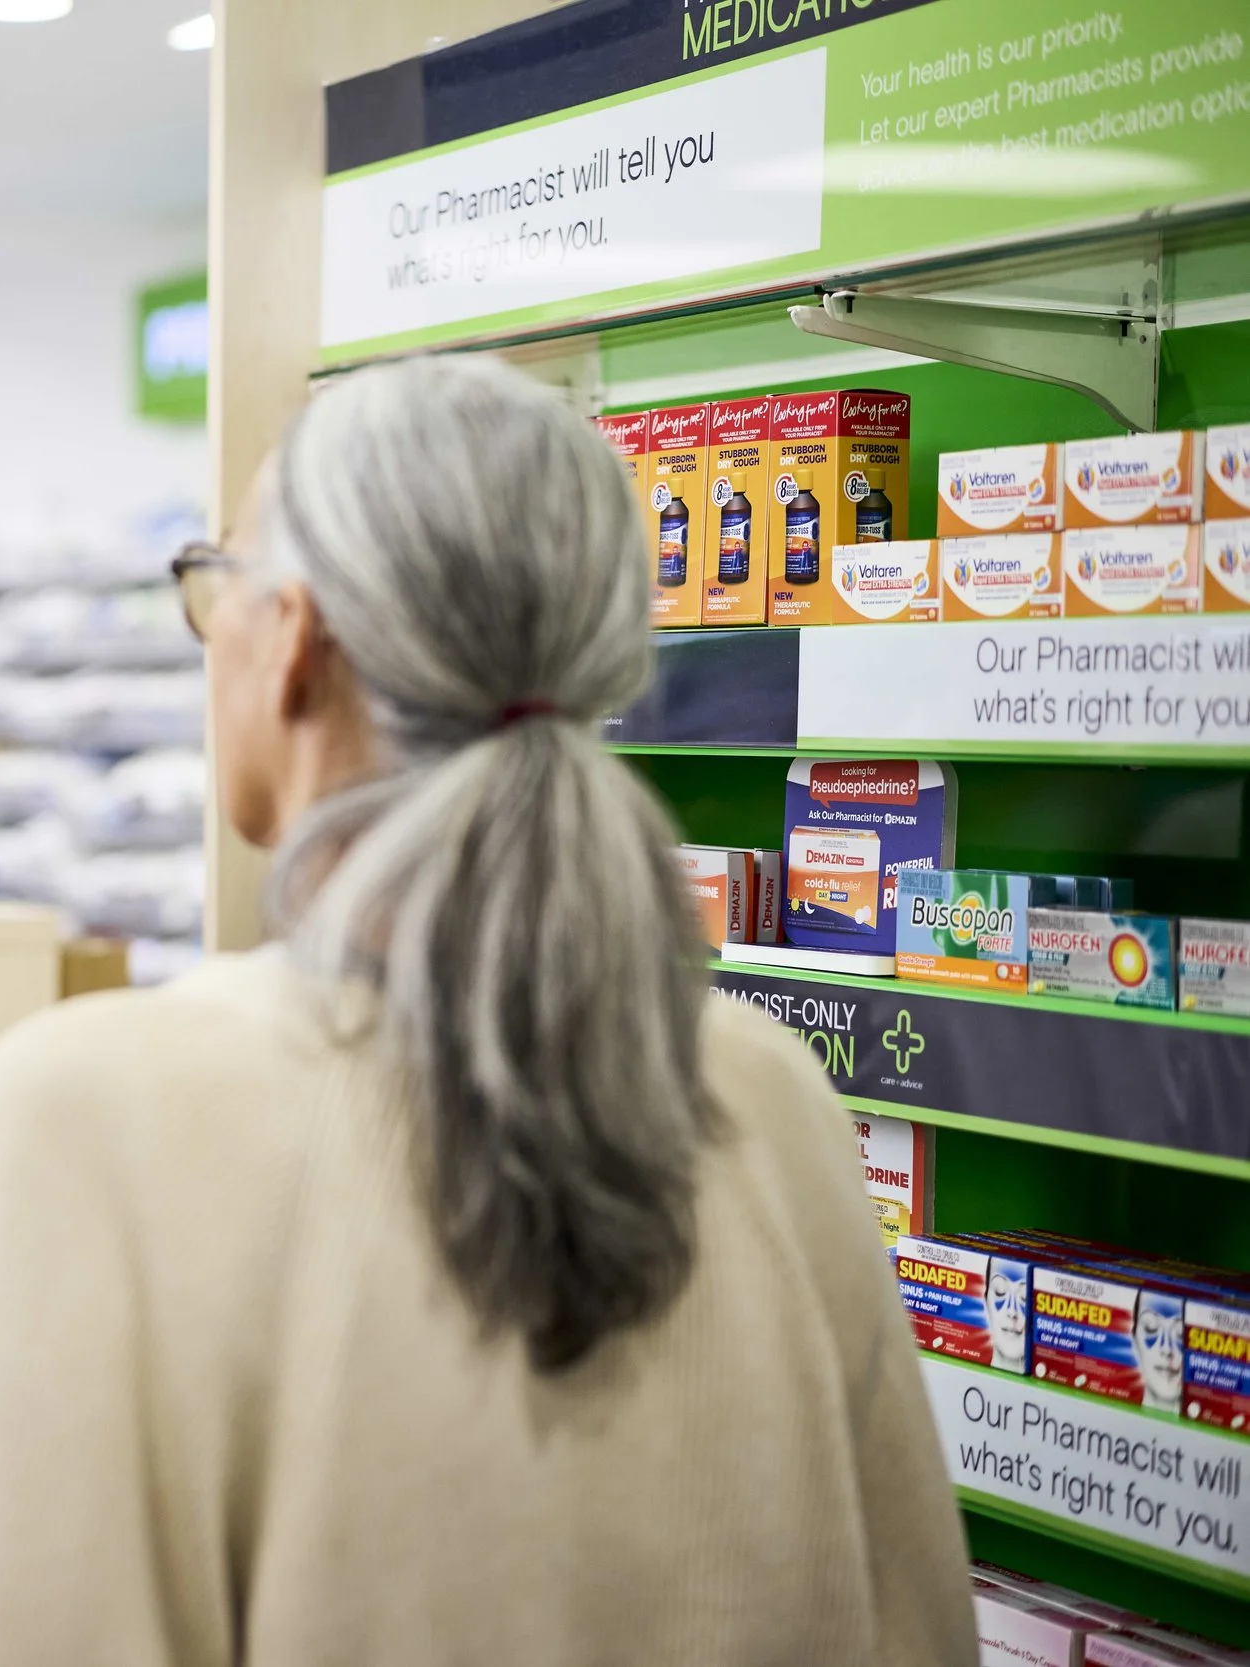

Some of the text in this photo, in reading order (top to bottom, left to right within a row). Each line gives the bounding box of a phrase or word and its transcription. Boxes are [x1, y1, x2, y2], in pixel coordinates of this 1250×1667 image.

[682, 0, 886, 60] MEDICA
[861, 11, 1124, 100] Your health is our priority.
[860, 29, 1244, 146] Let our expert Pharmacists provide
[1000, 127, 1049, 162] best
[1055, 95, 1185, 147] medication
[388, 131, 714, 239] Our Pharmacist will tell you
[518, 222, 552, 261] for
[558, 217, 608, 265] you.
[719, 448, 759, 459] STUBBORN
[781, 444, 826, 456] STUBBORN
[851, 444, 898, 454] STUBBORN
[658, 454, 696, 465] STUBBORN
[717, 458, 760, 469] DRY COUGH
[780, 455, 827, 466] DRY COUGH
[850, 453, 900, 464] DRY COUGH
[656, 464, 697, 475] DRY COUGH
[1097, 461, 1149, 476] Voltaren
[969, 472, 1016, 486] Voltaren
[973, 558, 1021, 573] Voltaren
[1099, 551, 1153, 566] Voltaren
[859, 565, 902, 579] Voltaren
[708, 587, 725, 596] NEW
[774, 592, 794, 600] NEW
[774, 601, 811, 609] THERAPEUTIC
[774, 608, 800, 616] FORMULA
[976, 637, 1027, 674] Our
[1037, 635, 1203, 673] Pharmacist
[973, 688, 1056, 724] what's
[1066, 688, 1133, 735] right
[1144, 685, 1186, 727] for
[842, 766, 877, 778] Looking for
[812, 779, 916, 797] Pseudoephedrine?
[808, 810, 918, 825] Ask Our Pharmacist for DEMAZIN
[806, 850, 846, 865] DEMAZIN
[885, 857, 934, 876] POWERFUL
[841, 880, 861, 892] relief
[731, 879, 741, 931] DEMAZIN
[762, 876, 774, 929] DEMAZIN
[911, 896, 1013, 938] Buscopan
[977, 936, 1012, 951] FORTE
[1031, 931, 1101, 953] NUROFEN
[1184, 943, 1250, 966] NUROFE
[881, 1077, 923, 1090] care advice
[862, 1165, 909, 1189] DRINE
[883, 1222, 900, 1233] Night
[899, 1260, 966, 1291] SUDAFED
[899, 1284, 923, 1298] SINUS
[928, 1291, 941, 1301] PAIN
[942, 1293, 962, 1306] RELIEF
[903, 1299, 914, 1307] DAY
[920, 1302, 938, 1312] NIGHT
[1036, 1292, 1111, 1328] SUDAFED
[1037, 1318, 1062, 1333] SINUS
[1040, 1333, 1052, 1342] DAY
[1188, 1327, 1250, 1364] SUDAF
[963, 1386, 1242, 1500] Our Pharmacist will
[960, 1441, 1239, 1554] what's right for you.
